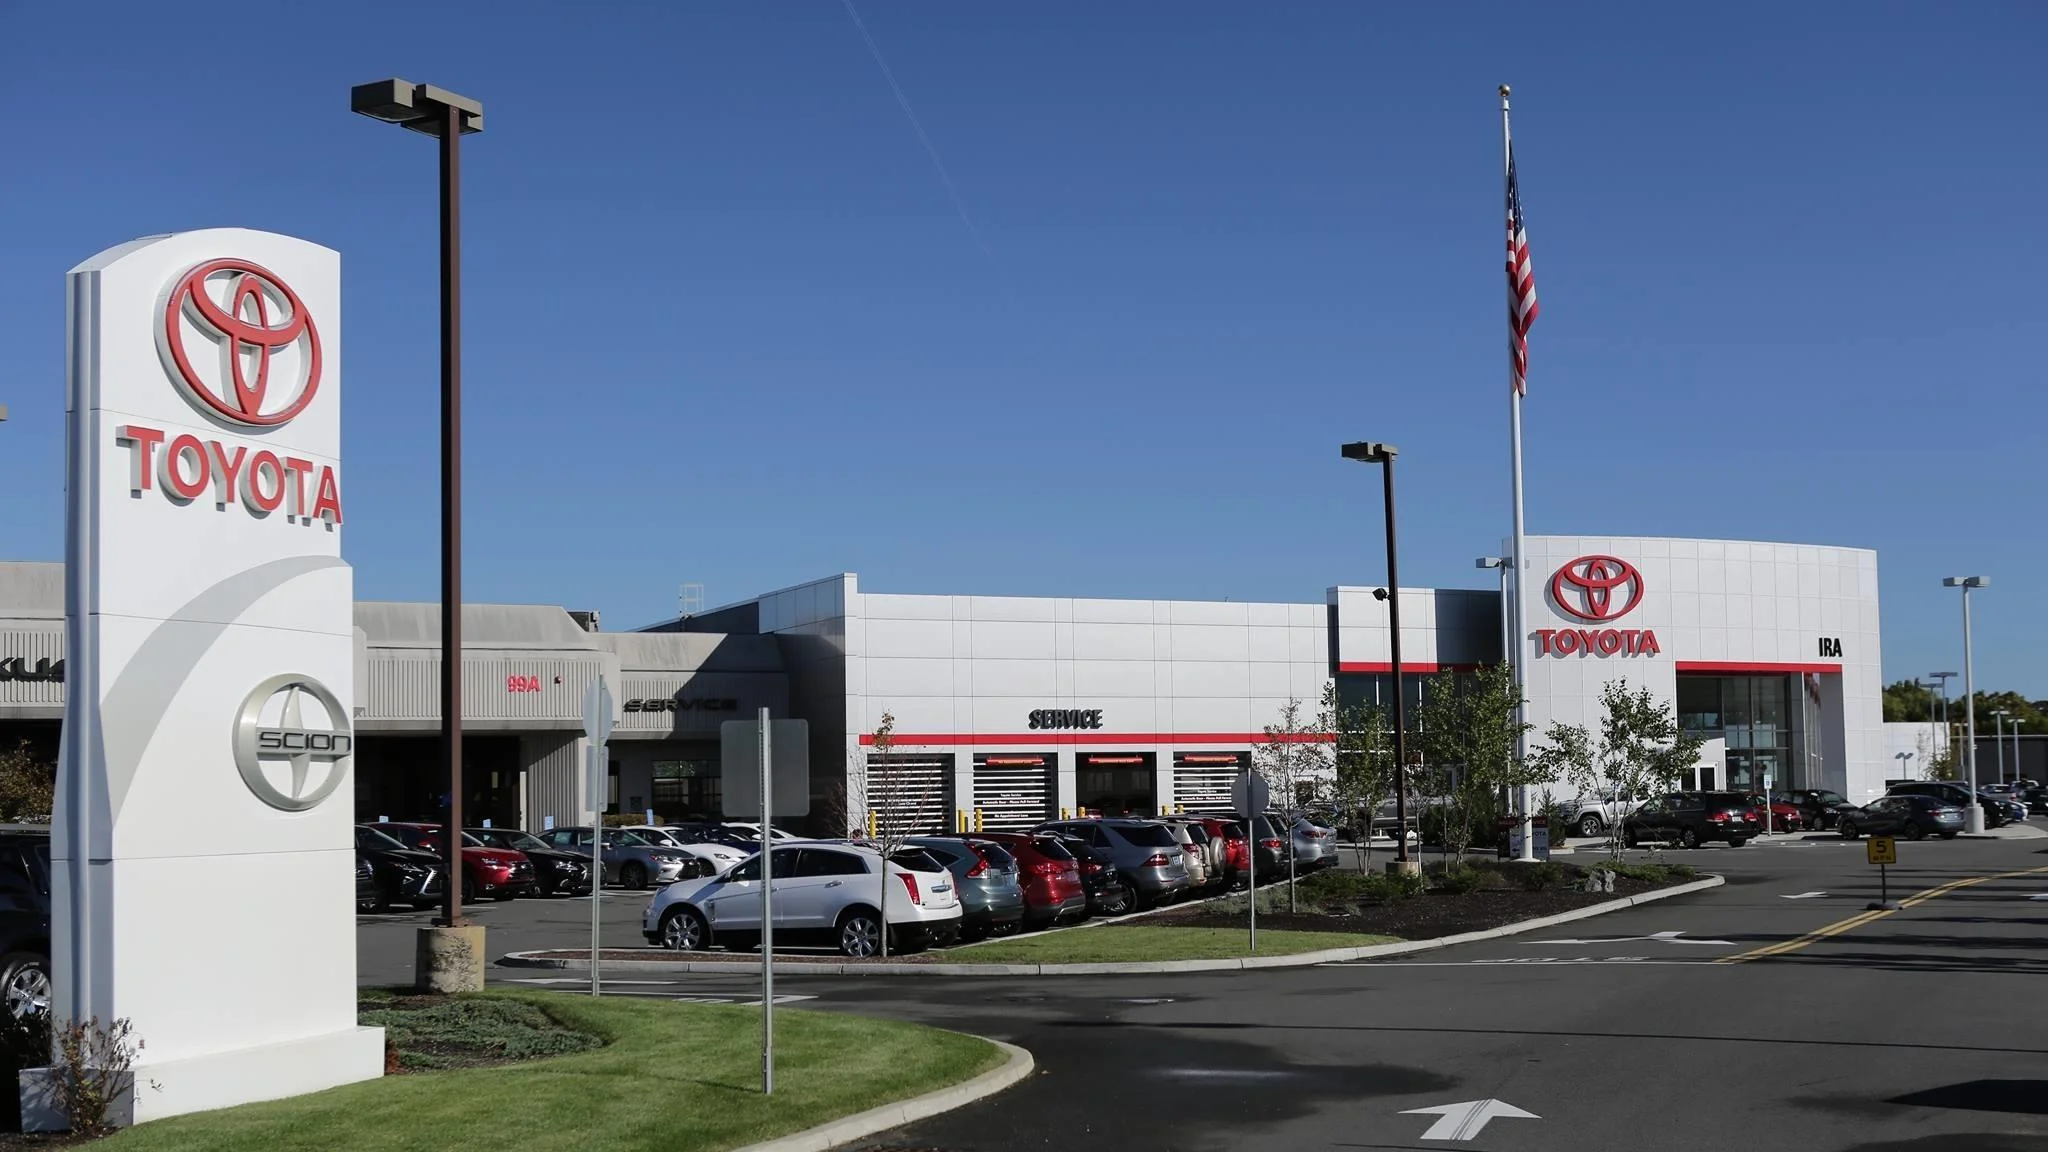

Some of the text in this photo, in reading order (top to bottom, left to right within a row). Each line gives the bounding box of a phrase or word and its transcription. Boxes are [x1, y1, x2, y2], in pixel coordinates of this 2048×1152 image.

[121, 425, 342, 525] TOYOTA
[1535, 628, 1660, 655] TOYOTA
[1818, 637, 1843, 657] IRA
[507, 675, 541, 692] 99A
[623, 698, 737, 712] SERVICE
[1028, 708, 1103, 730] SERVICE
[1876, 841, 1887, 853] 5
